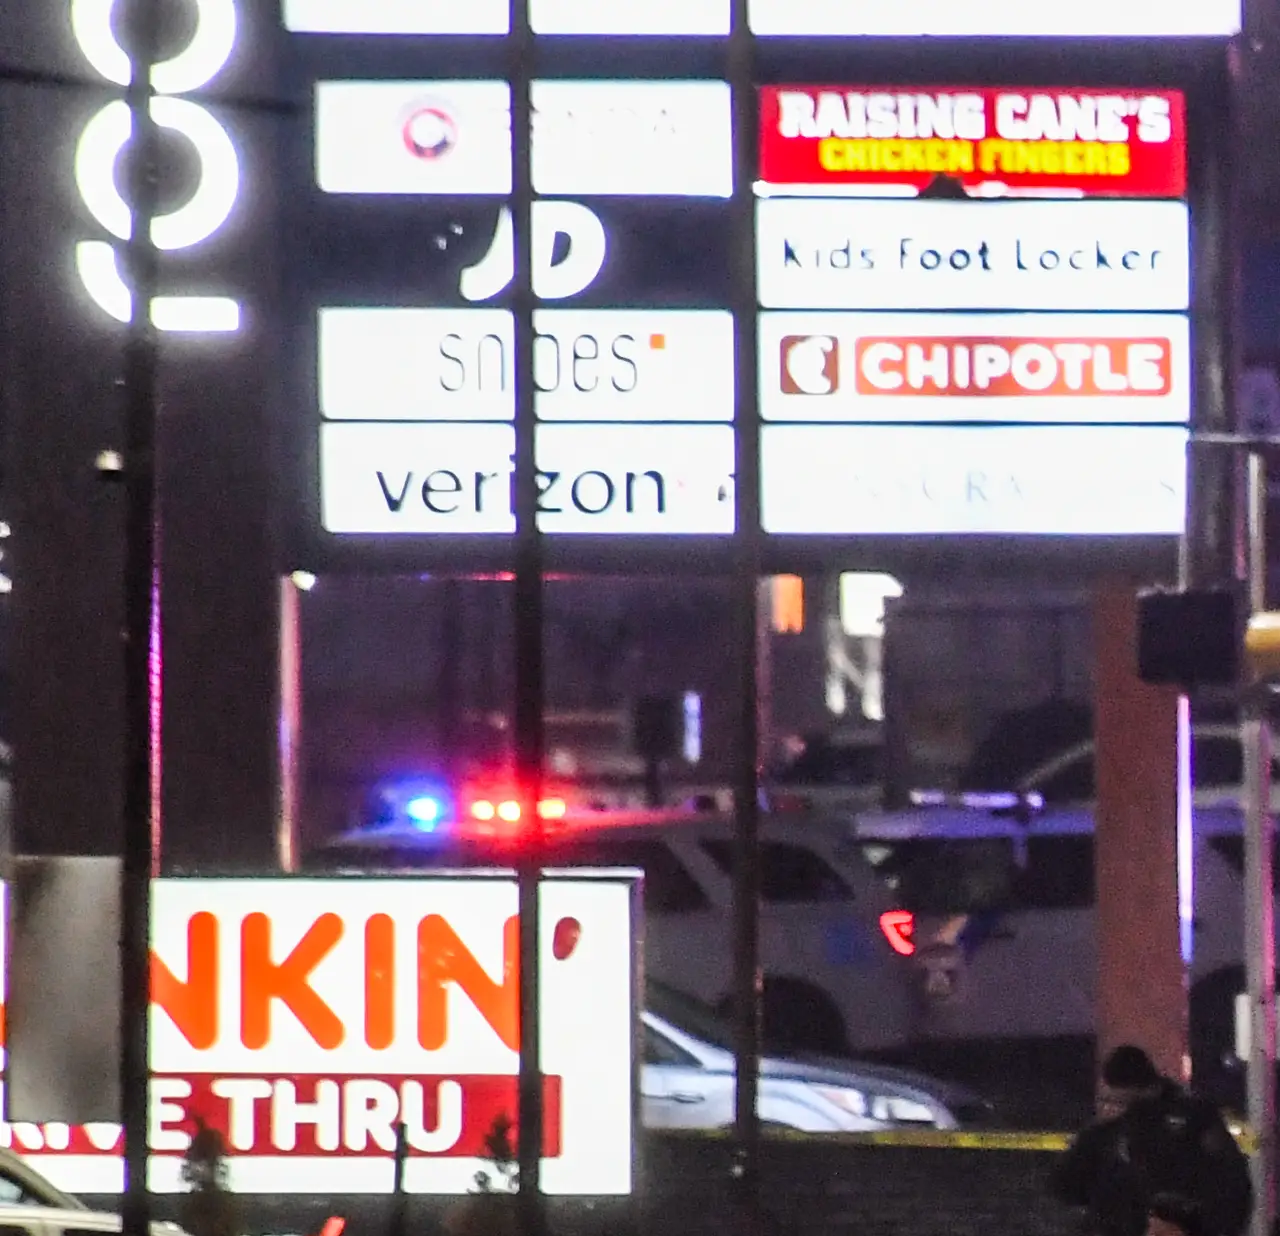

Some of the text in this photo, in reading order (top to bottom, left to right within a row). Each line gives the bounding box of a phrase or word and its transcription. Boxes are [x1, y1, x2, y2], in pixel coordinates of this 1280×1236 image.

[776, 91, 1171, 143] RAISING CANE'S
[816, 138, 1131, 175] CHICKEN FINGERS
[458, 200, 607, 301] JD
[783, 239, 1163, 271] Kids Foot Locker
[860, 343, 1166, 392] CHIPOTLE
[210, 1079, 464, 1152] THRU
